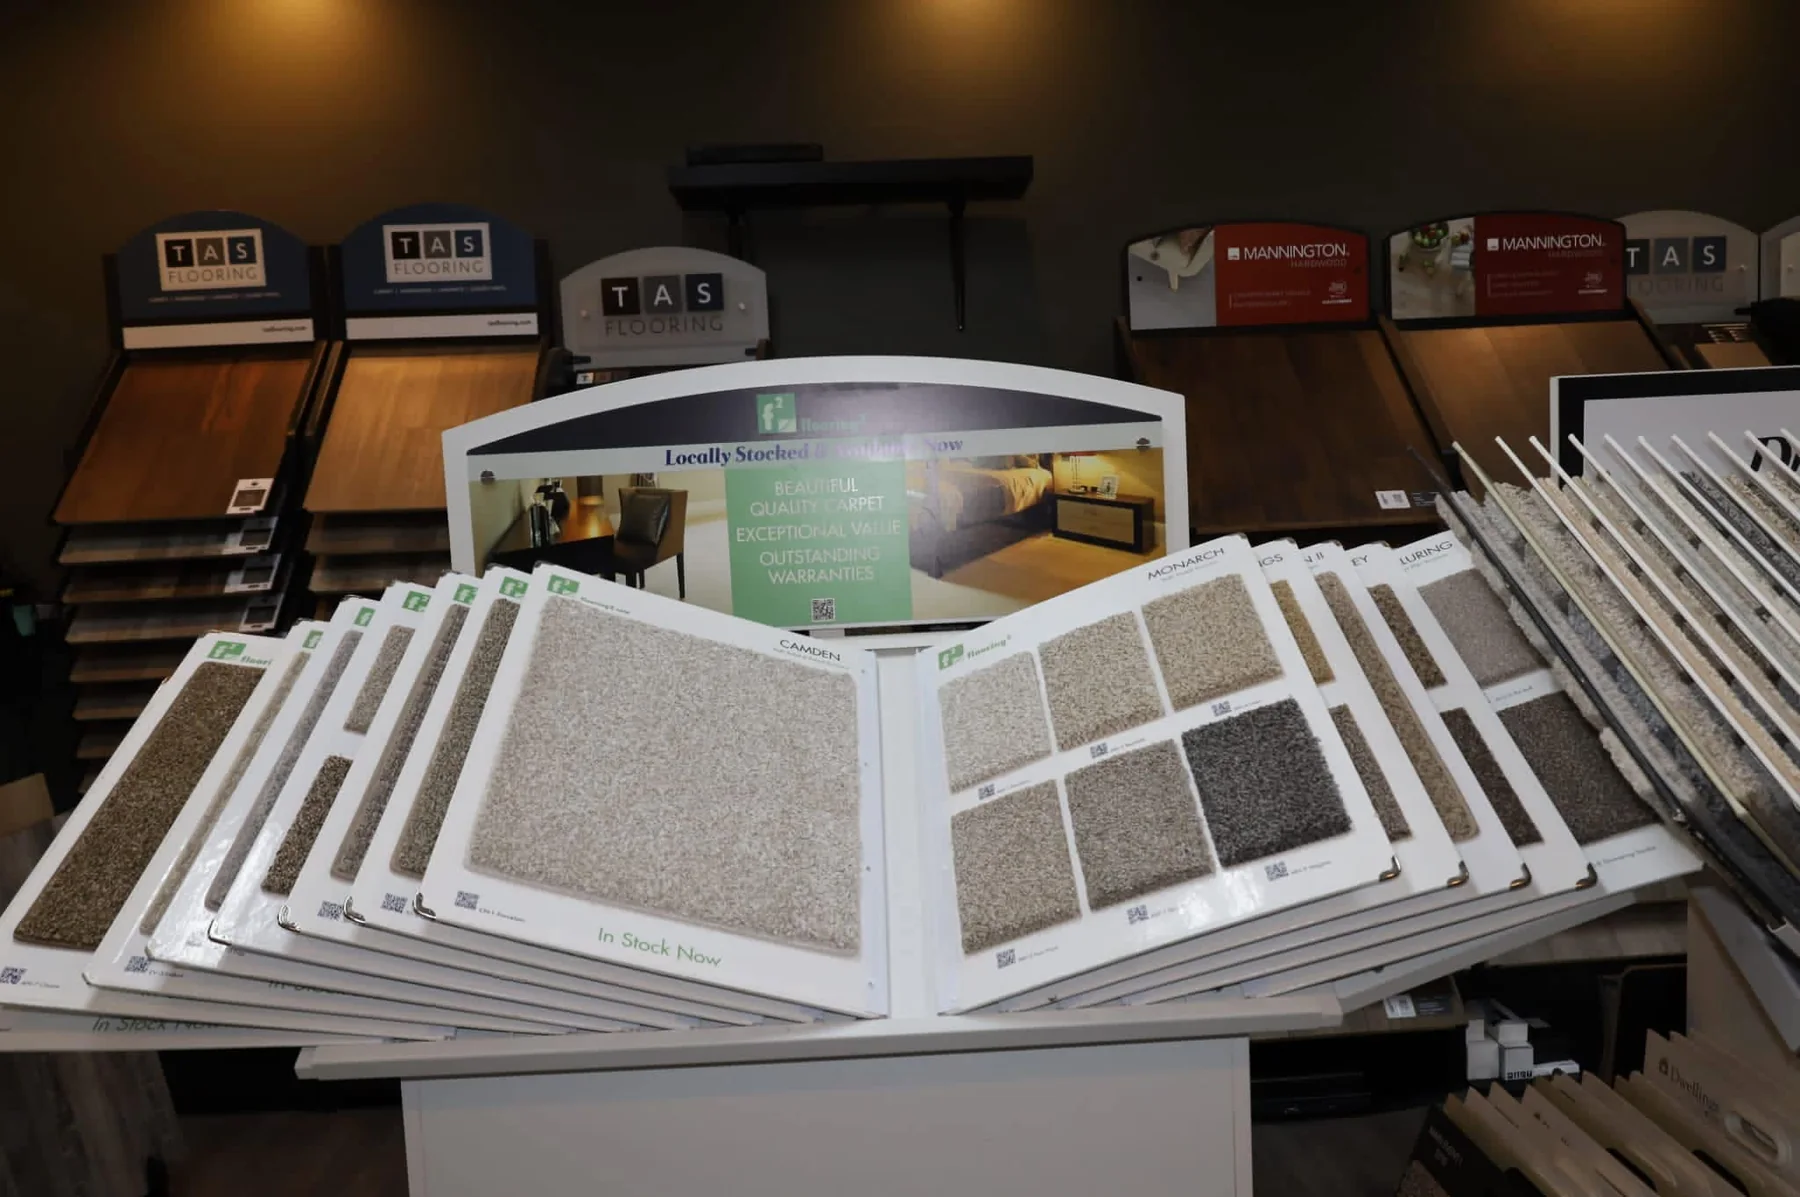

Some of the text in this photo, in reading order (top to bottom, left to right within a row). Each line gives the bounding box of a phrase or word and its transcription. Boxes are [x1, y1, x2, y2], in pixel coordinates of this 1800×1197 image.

[172, 242, 249, 262] TAS
[399, 236, 476, 254] TAS
[1625, 244, 1716, 268] TAS
[168, 267, 258, 284] FLOORING
[393, 260, 484, 276] FLOORING
[612, 283, 711, 308] TAS
[605, 315, 724, 336] FLOORING
[665, 447, 731, 467] Locally
[735, 443, 809, 462] Stocked
[774, 477, 858, 496] BEAUTIFUL
[750, 495, 885, 516] QUALITY CARPET
[736, 519, 901, 542] EXCEPTIONAL VALUE
[759, 546, 881, 566] OUTSTANDING
[1148, 547, 1225, 580] MONARCH
[767, 565, 875, 585] WARRANTIES
[779, 639, 841, 661] CAMDEN
[598, 927, 722, 968] In Stock Now
